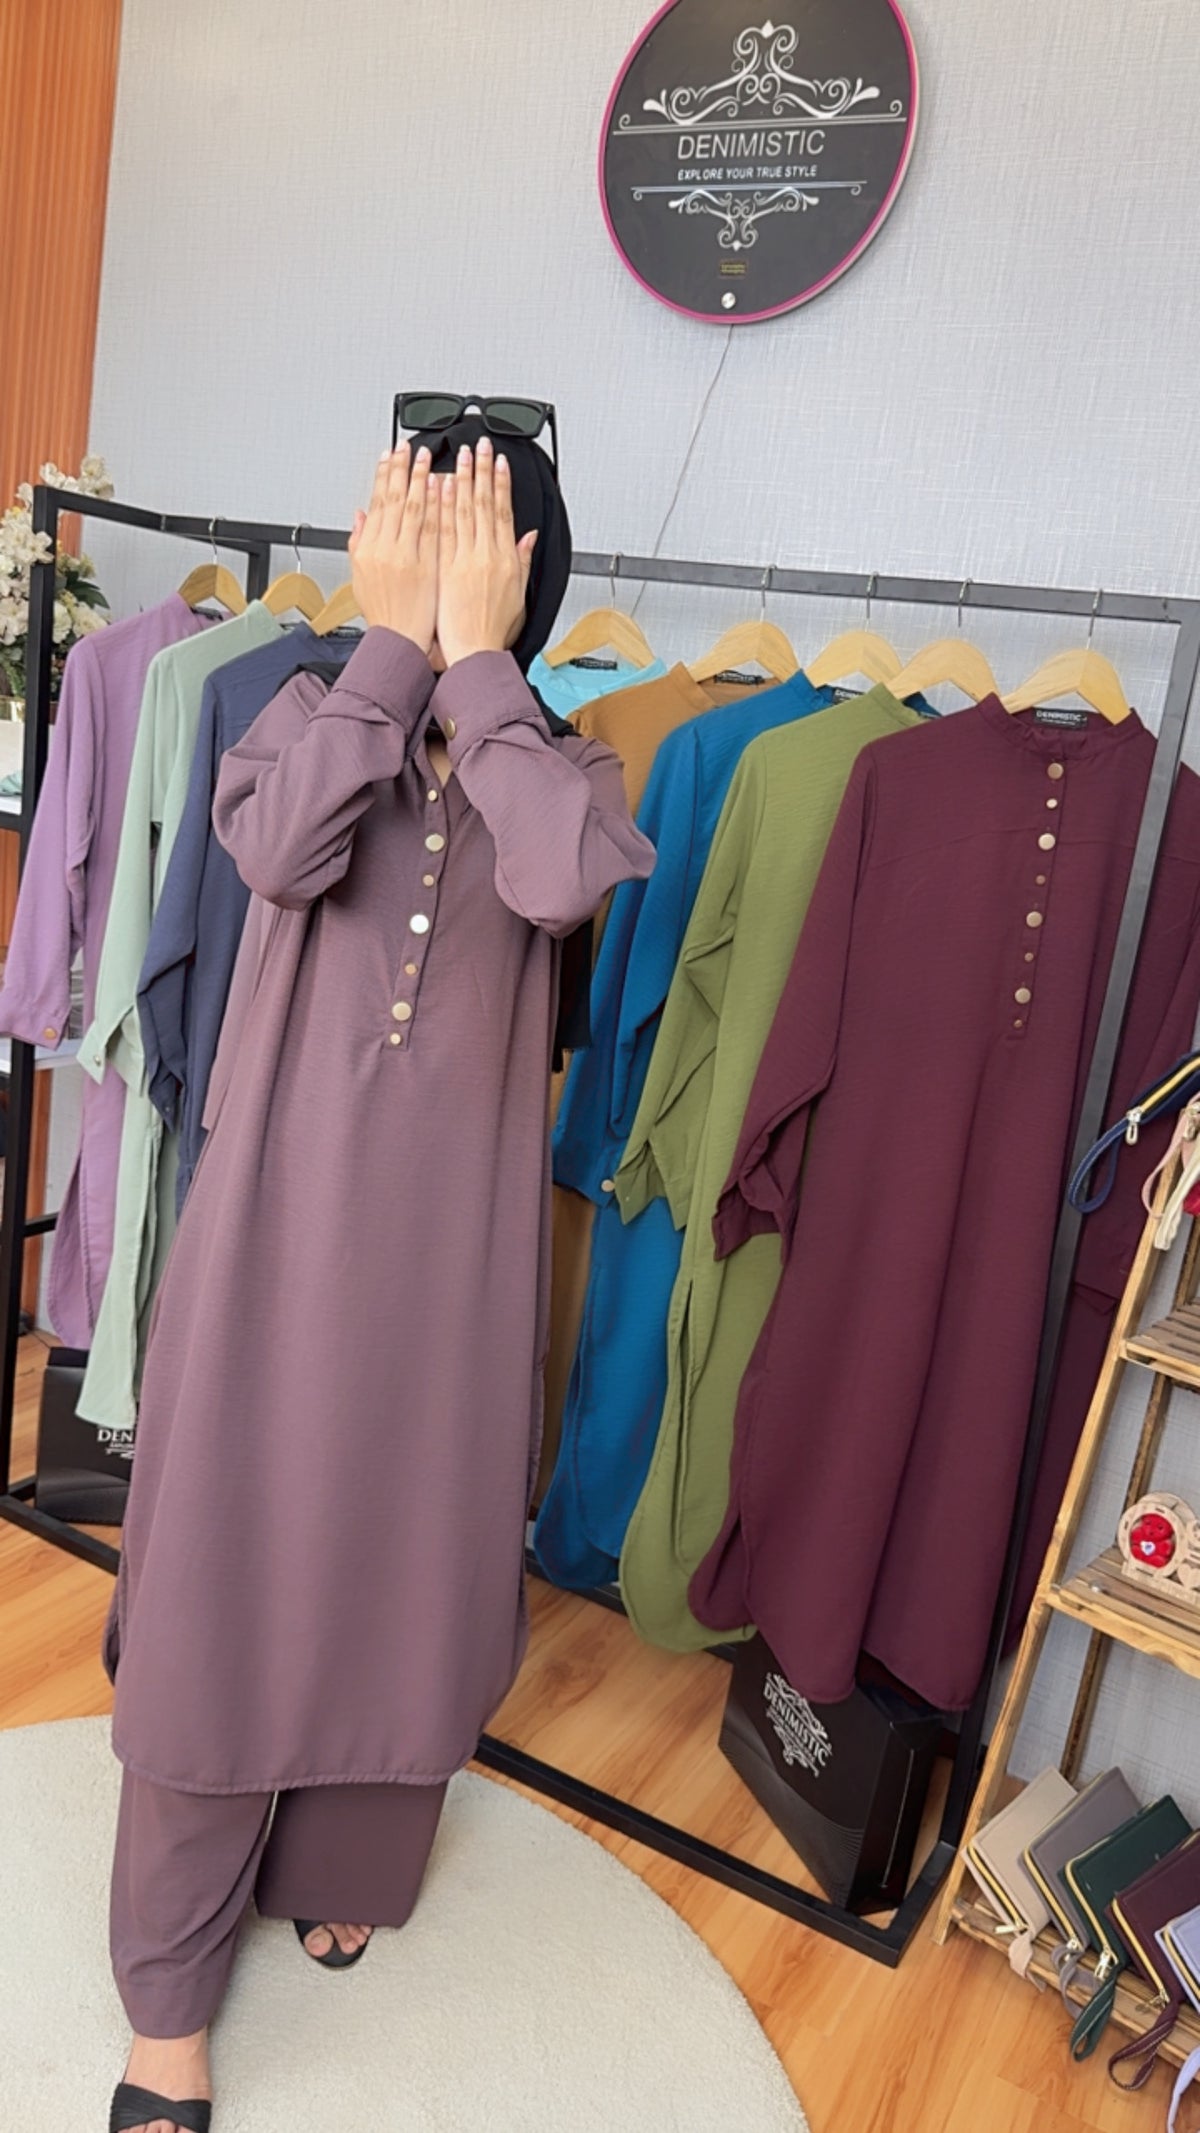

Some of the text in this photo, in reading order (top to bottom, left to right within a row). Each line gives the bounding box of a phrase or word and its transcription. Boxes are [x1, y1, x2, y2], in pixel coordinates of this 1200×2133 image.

[677, 129, 826, 160] DENIMISTIC
[677, 164, 818, 181] EXPLORE YOUR TRUE STYLE
[763, 1682, 829, 1766] DENIMISTIC
